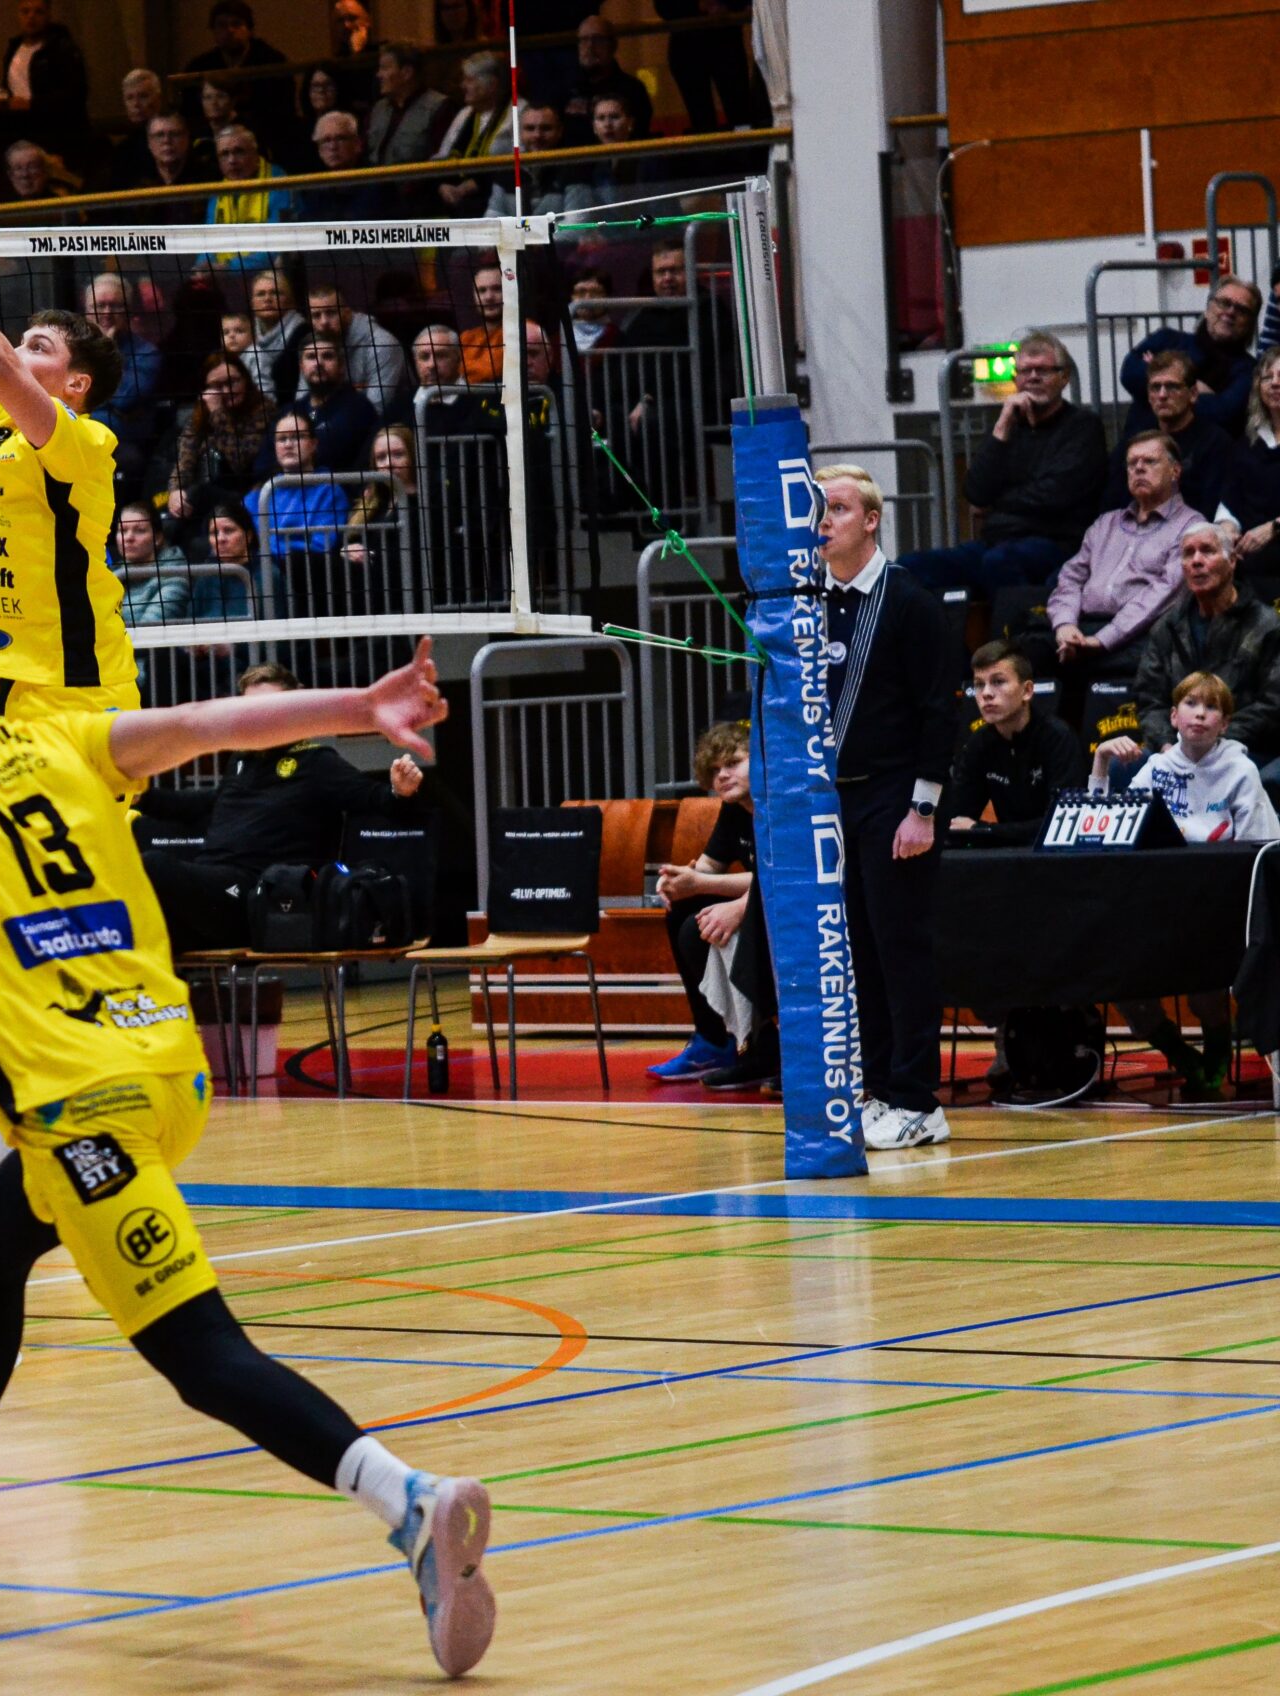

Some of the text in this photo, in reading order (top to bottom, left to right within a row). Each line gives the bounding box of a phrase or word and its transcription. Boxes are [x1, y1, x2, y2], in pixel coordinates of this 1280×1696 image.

[29, 232, 167, 253] TMI. PASI MERILÄINEN
[325, 225, 451, 245] TMI. PASI MERILÄINEN
[806, 735, 831, 783] OY
[1051, 807, 1140, 842] 11 0 0 11
[817, 903, 853, 1146] RAKENNUS OY
[124, 1211, 171, 1262] BE
[134, 1251, 197, 1298] BE GROUP
